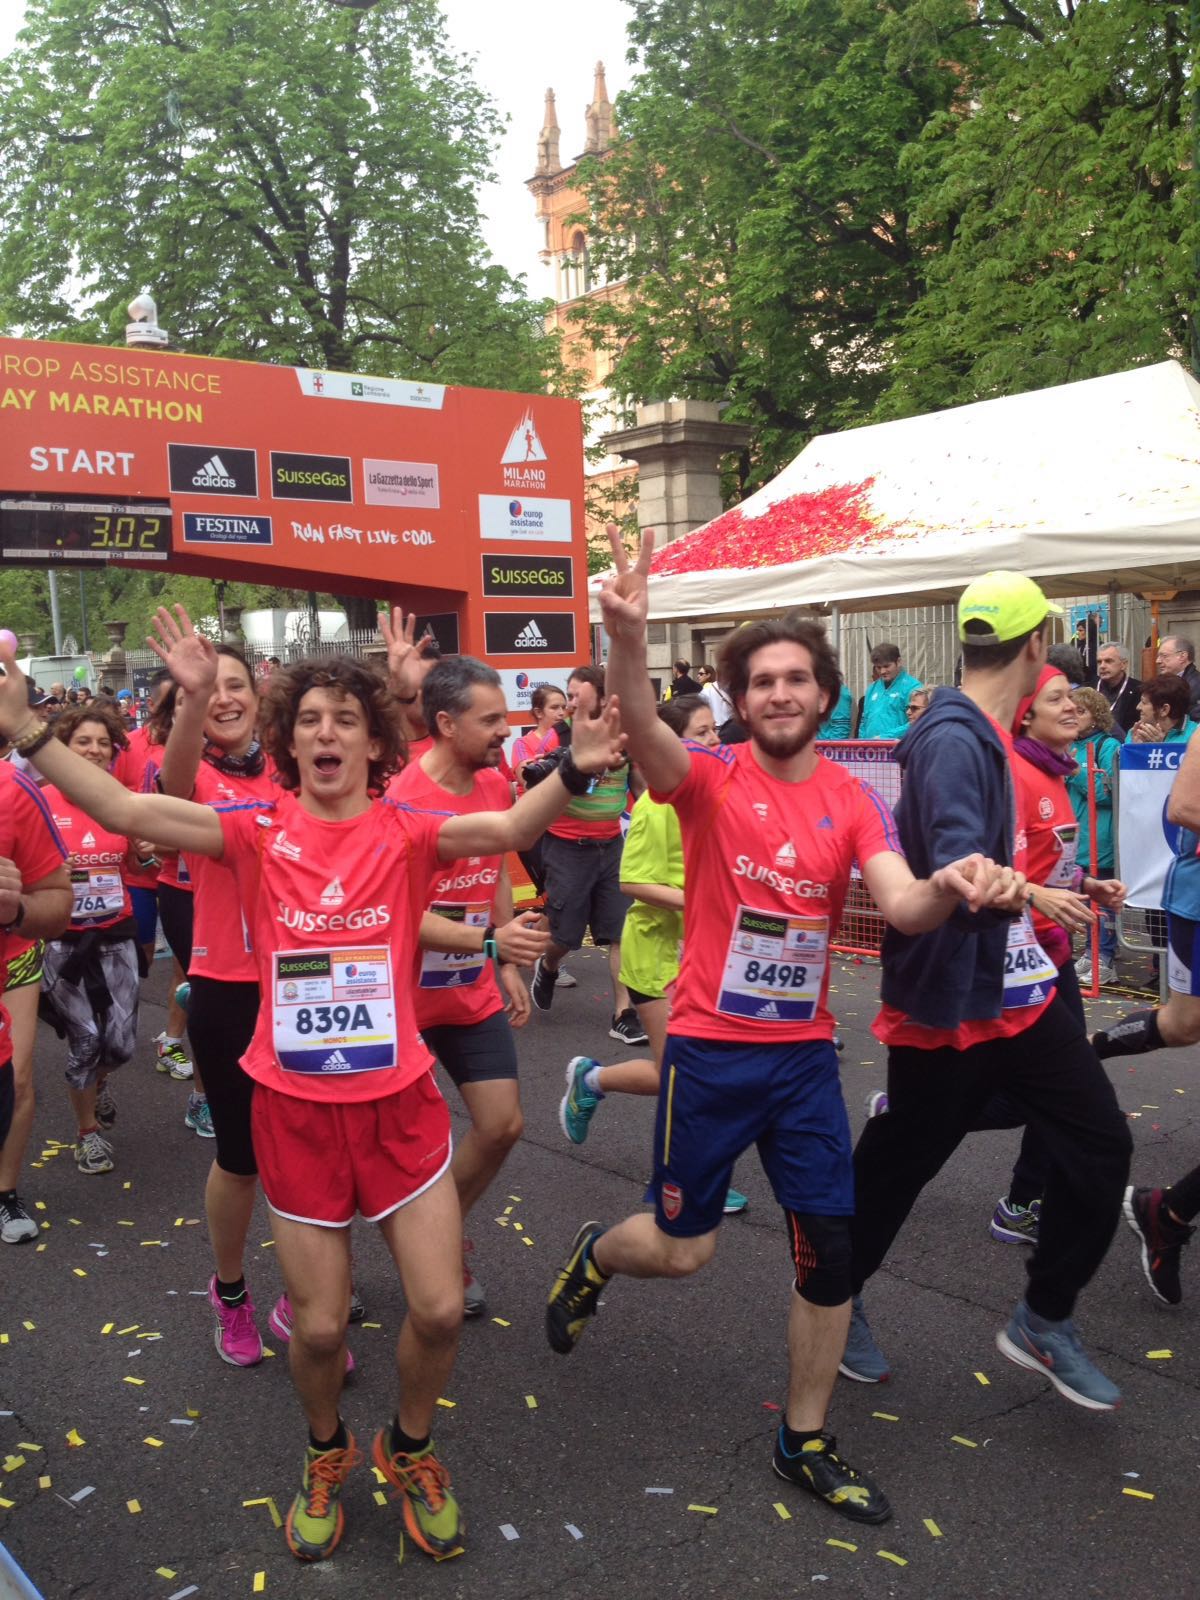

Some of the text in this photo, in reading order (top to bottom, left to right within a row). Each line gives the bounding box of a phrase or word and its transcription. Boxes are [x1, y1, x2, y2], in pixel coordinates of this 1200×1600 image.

[0, 356, 222, 394] ROP ASSISTANCE
[49, 391, 203, 423] MARATHON
[30, 447, 135, 476] START
[192, 475, 236, 488] adidas
[276, 468, 346, 487] SuisseGas
[369, 472, 433, 489] La Gazzetta dello Sport
[503, 467, 545, 481] MILANO
[503, 480, 545, 489] MARATHON
[523, 510, 543, 519] europ
[195, 517, 261, 534] FESTINA
[510, 519, 543, 528] assistance
[329, 523, 362, 544] FAST
[368, 530, 398, 545] LIVE
[402, 529, 436, 545] COOL
[491, 567, 565, 585] SuisseGas
[514, 637, 548, 648] adidas
[744, 960, 807, 987] 849B
[296, 1004, 373, 1034] 839A
